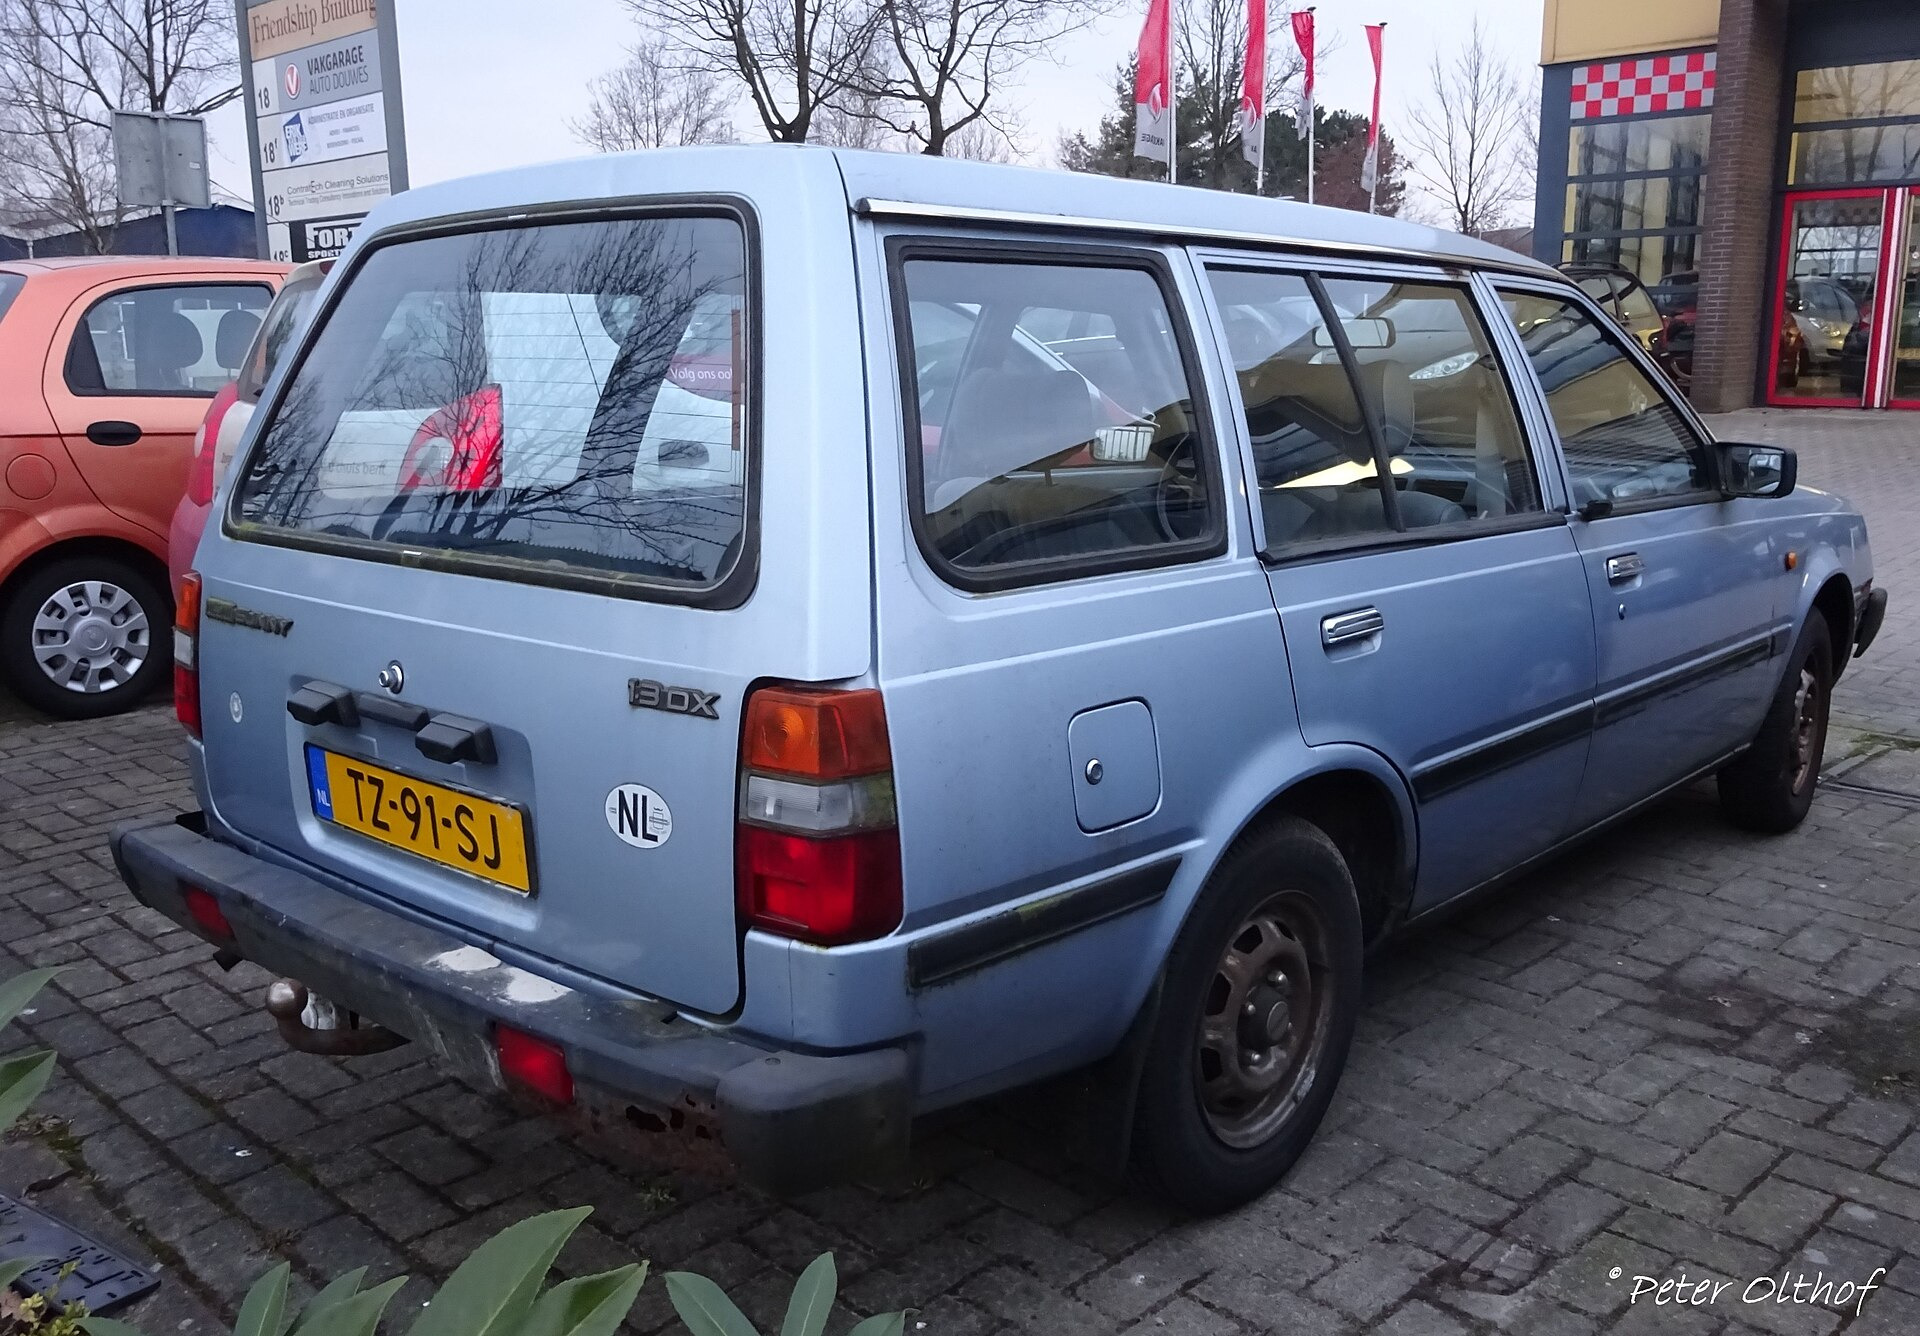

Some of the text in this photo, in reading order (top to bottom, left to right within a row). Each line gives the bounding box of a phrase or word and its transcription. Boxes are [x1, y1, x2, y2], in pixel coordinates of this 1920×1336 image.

[252, 0, 377, 43] Friendship Building
[307, 46, 364, 75] VAKGARAGE
[310, 66, 369, 94] AUTO DOUWES
[258, 87, 270, 109] 18
[325, 178, 354, 189] Cleaning
[356, 173, 388, 185] Solutions
[670, 367, 696, 382] Volg
[697, 370, 716, 379] ons
[317, 788, 330, 807] NL
[346, 767, 501, 870] TZ-91-SJ
[618, 789, 659, 843] NL
